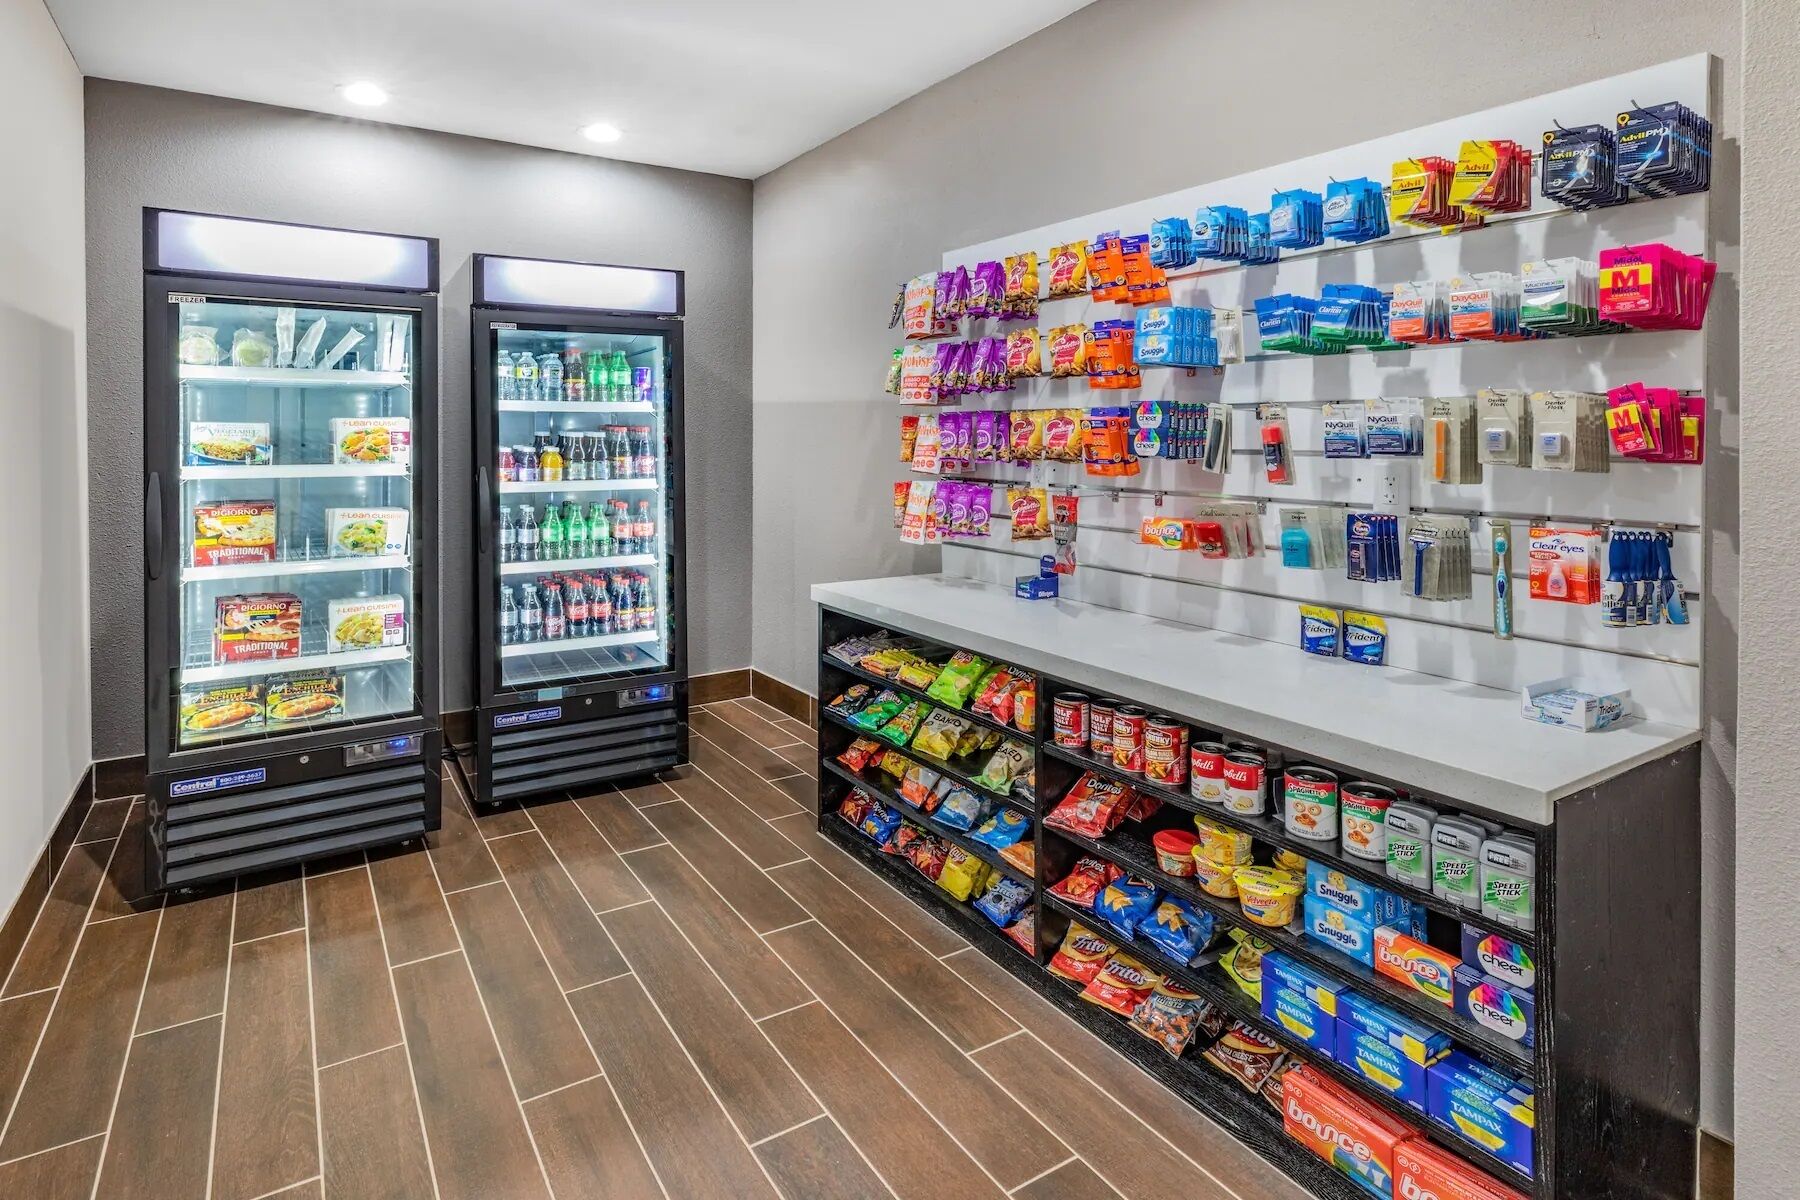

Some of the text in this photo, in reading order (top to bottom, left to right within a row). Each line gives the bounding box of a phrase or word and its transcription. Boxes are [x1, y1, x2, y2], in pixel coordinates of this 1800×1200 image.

[1620, 128, 1663, 143] Advil PM
[1549, 151, 1573, 161] Advil
[1398, 180, 1421, 190] Advil
[1614, 255, 1642, 264] Midol
[1612, 269, 1639, 288] M
[1452, 291, 1488, 302] DayQuil
[1612, 286, 1640, 295] Midol
[170, 295, 205, 304] FREEZER
[1391, 298, 1423, 308] DayQuil
[1318, 306, 1342, 315] Claritin
[1143, 317, 1168, 331] Snuggle
[1260, 318, 1281, 328] Claritin
[1141, 344, 1166, 357] Snuggle
[1367, 415, 1398, 424] NyQuil
[1613, 409, 1632, 427] M
[1325, 422, 1354, 430] NyQuil
[1144, 525, 1177, 538] bounce
[207, 546, 264, 559] TRADITIONAL
[1532, 541, 1585, 554] Clear eyes
[1602, 600, 1625, 608] oller
[1304, 624, 1335, 634] Trident
[1347, 632, 1382, 642] Trident
[232, 641, 289, 654] TRADITIONAL
[1599, 703, 1622, 716] Trident
[997, 745, 1022, 763] BAED
[1223, 767, 1247, 782] pbell's
[174, 779, 217, 792] Central
[1086, 778, 1122, 795] Doritos
[1392, 842, 1415, 851] SPEED
[1442, 861, 1467, 869] SPEED
[1445, 868, 1467, 876] STICK
[1493, 881, 1521, 890] SPEED
[1320, 883, 1359, 907] Snuggle
[1496, 889, 1521, 897] STICK
[1318, 922, 1358, 947] Snuggle
[1379, 946, 1439, 980] bounce
[1482, 952, 1525, 978] cheer
[1274, 966, 1304, 986] TAMPAX
[1275, 999, 1314, 1026] TAMPAX
[1472, 1001, 1516, 1029] cheer
[1351, 1010, 1388, 1032] TAMPAX
[1356, 1046, 1401, 1076] TAMPAX
[1454, 1072, 1498, 1097] TAMPAX
[1451, 1100, 1504, 1135] TAMPAX
[1286, 1097, 1373, 1162] bounce
